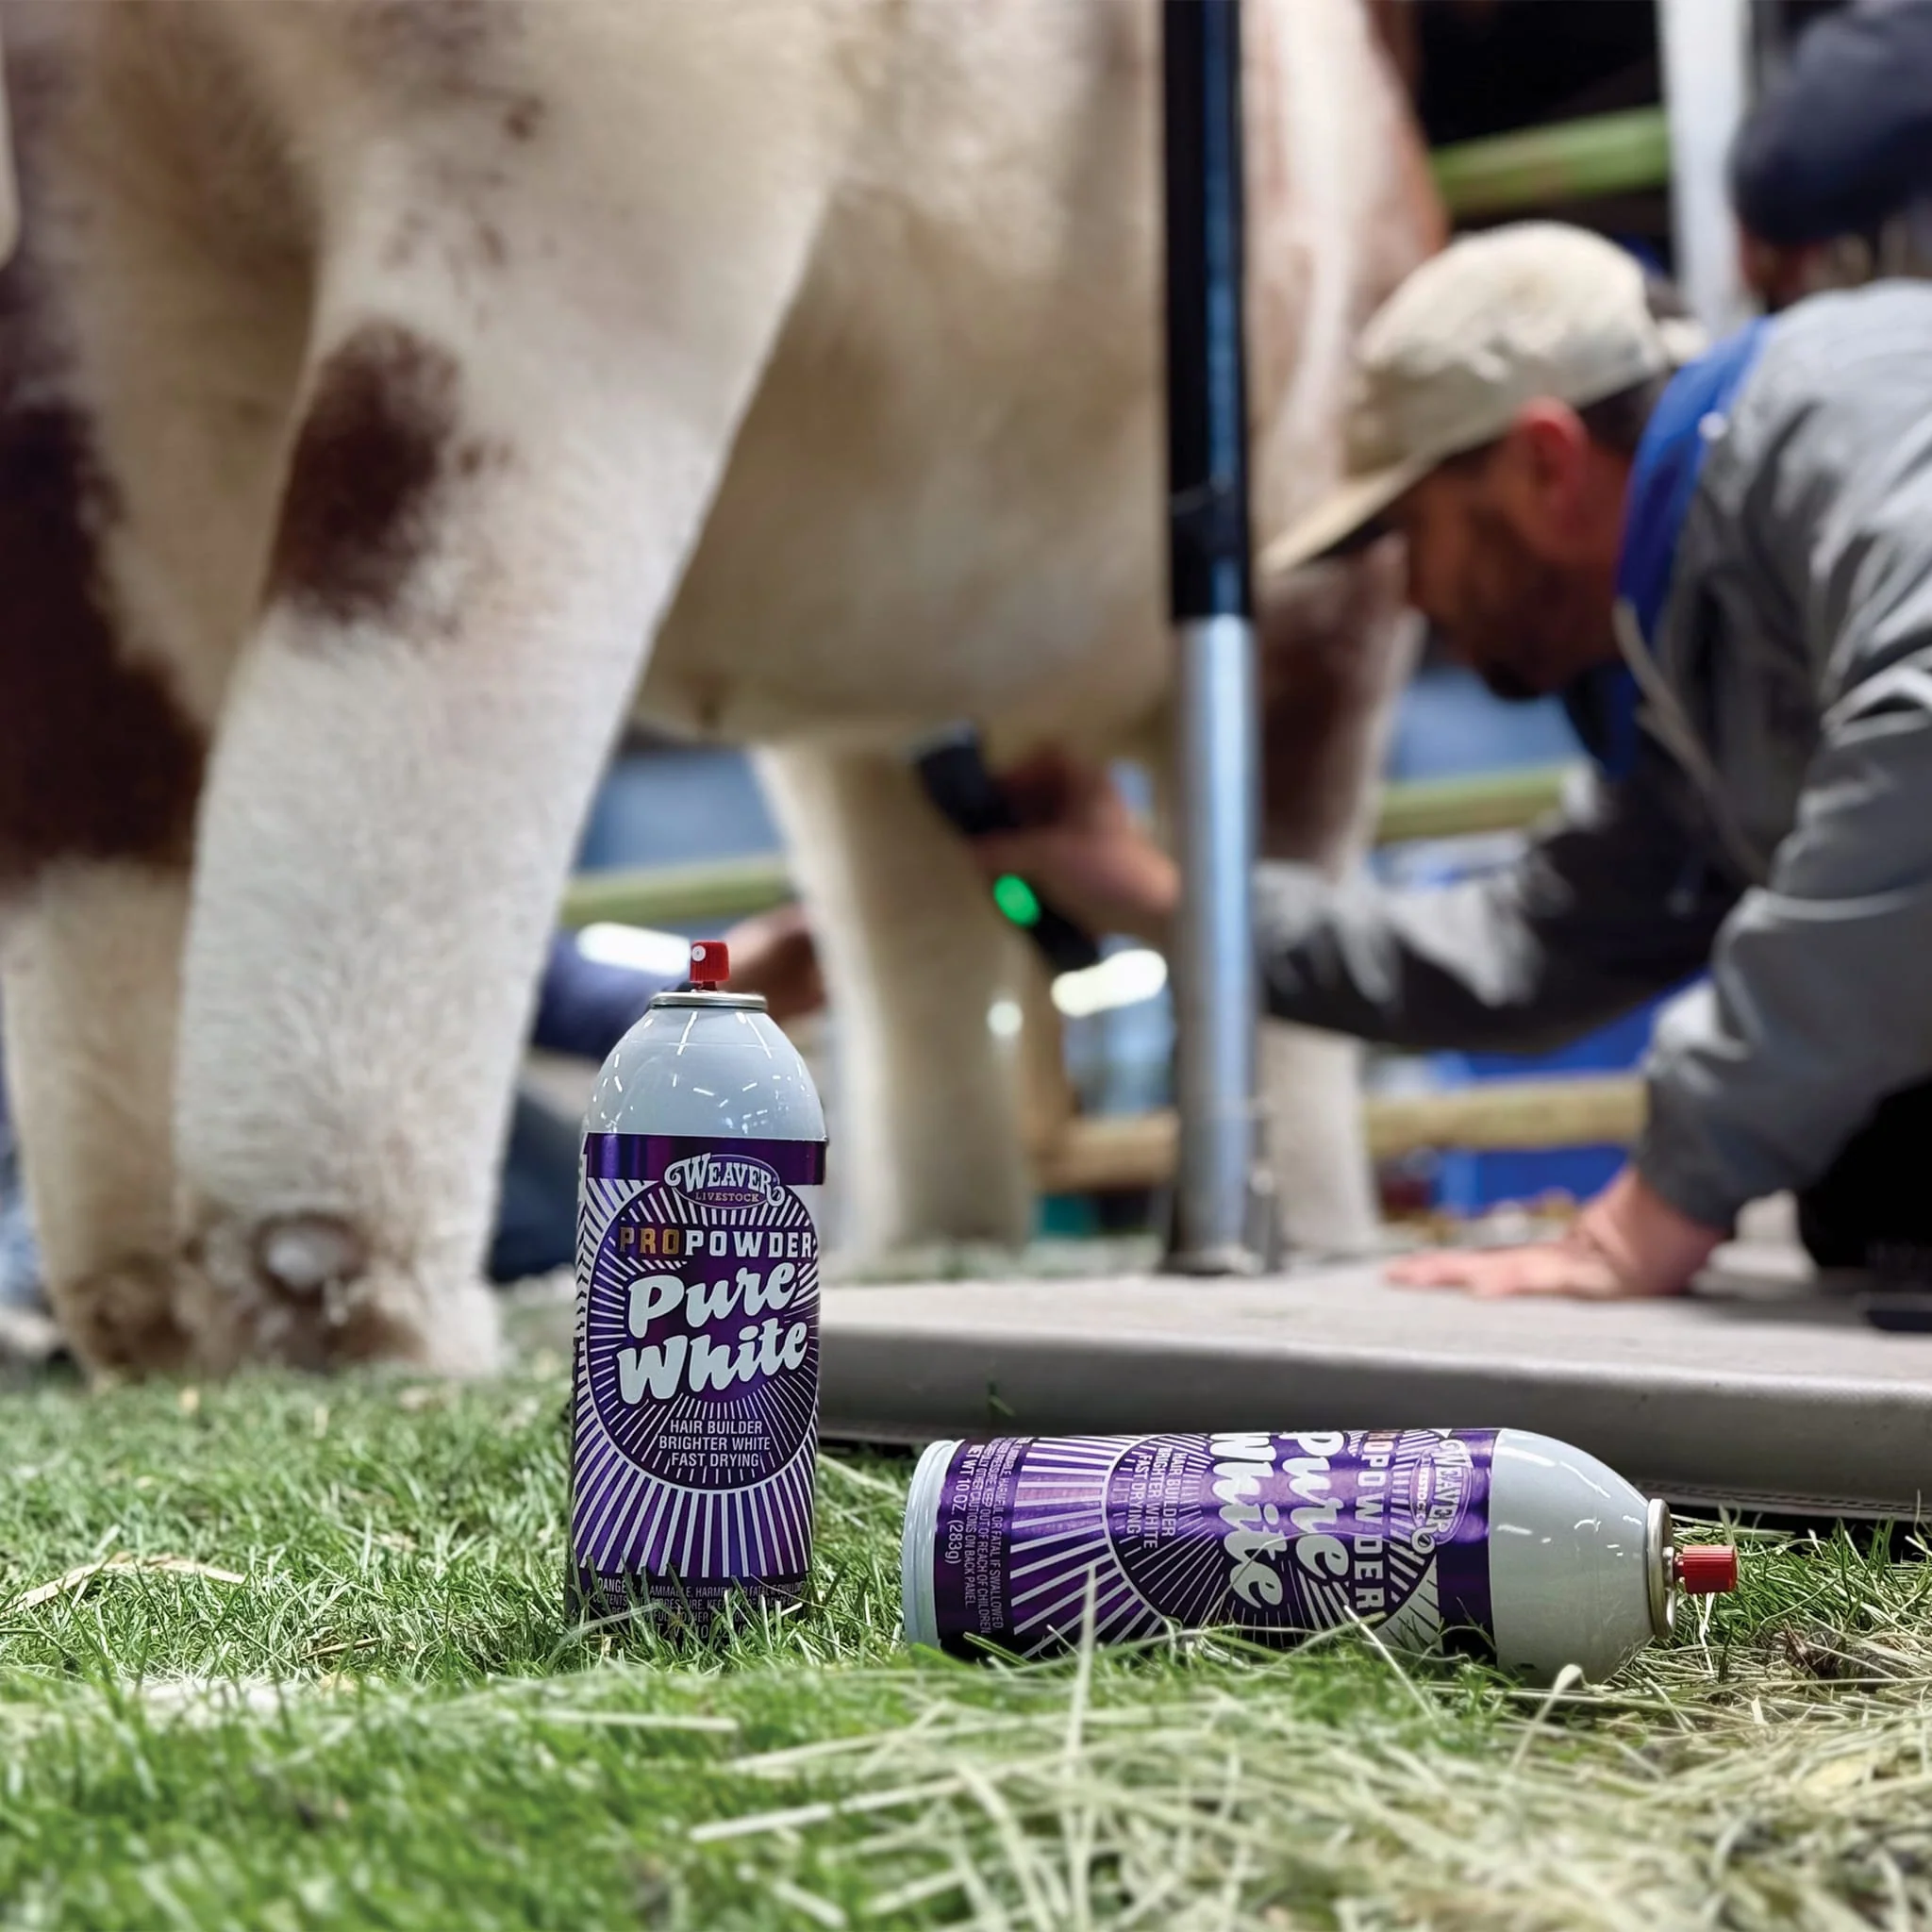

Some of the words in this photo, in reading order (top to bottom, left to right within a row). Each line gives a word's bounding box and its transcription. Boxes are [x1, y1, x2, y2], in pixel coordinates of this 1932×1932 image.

[664, 1152, 785, 1207] WEAVER
[695, 1191, 759, 1203] LIVESTOCK
[627, 1262, 797, 1339] Pure
[617, 1318, 808, 1405] White
[670, 1420, 703, 1433] HAIR
[708, 1421, 762, 1434] BUILDER
[659, 1435, 727, 1450] BRIGHTER
[732, 1437, 771, 1450] WHITE
[965, 1444, 985, 1459] NET
[671, 1453, 706, 1466] FAST
[709, 1454, 759, 1467] DRYING
[959, 1459, 978, 1475] WT
[1133, 1455, 1153, 1480] FAST
[1171, 1452, 1189, 1475] HAIR
[956, 1478, 972, 1491] 10
[1147, 1447, 1173, 1498] BRIGHTER
[951, 1494, 968, 1515] OZ.
[1126, 1482, 1146, 1534] DRYING
[1161, 1478, 1181, 1537] BUILDER
[1278, 1430, 1349, 1579] Pure
[1412, 1440, 1473, 1554] WEAVER
[965, 1491, 983, 1533] CAUTIONS
[979, 1508, 991, 1526] OUT
[991, 1516, 1003, 1529] OR
[1209, 1432, 1287, 1608] White
[977, 1528, 990, 1540] OF
[1143, 1502, 1160, 1549] WHITE
[944, 1519, 964, 1564] (283g)
[964, 1535, 976, 1548] ON
[990, 1530, 1003, 1557] FATAL
[964, 1550, 976, 1574] BACK
[976, 1541, 989, 1573] REACH
[990, 1559, 1001, 1568] IF
[976, 1574, 989, 1587] OF
